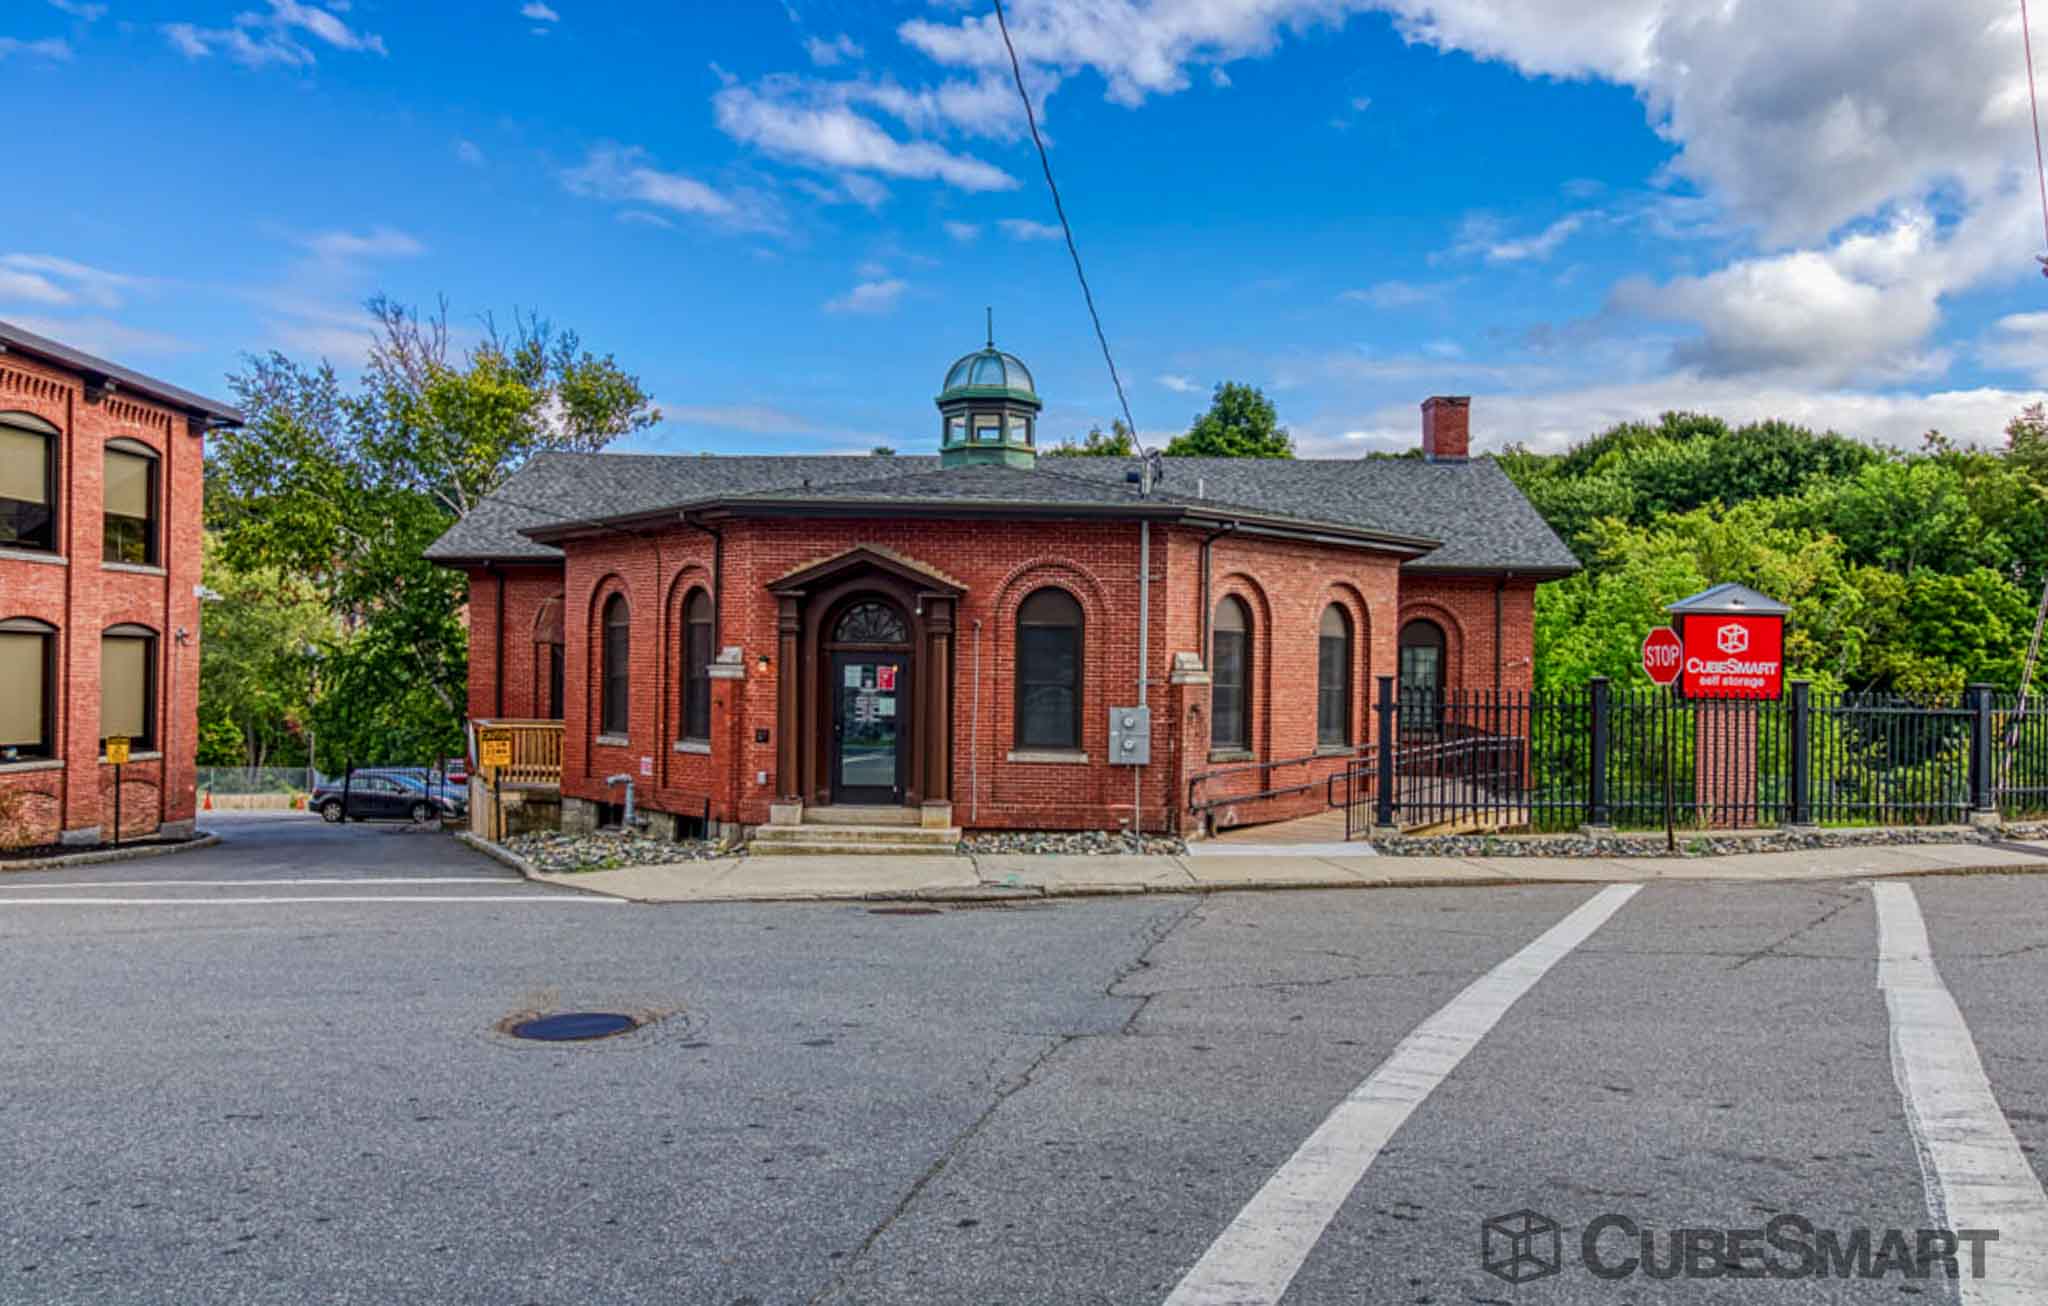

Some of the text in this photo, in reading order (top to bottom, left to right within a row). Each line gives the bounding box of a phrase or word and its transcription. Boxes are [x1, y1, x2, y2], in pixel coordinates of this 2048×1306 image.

[1645, 644, 1680, 667] STOP
[1699, 675, 1766, 688] self storage
